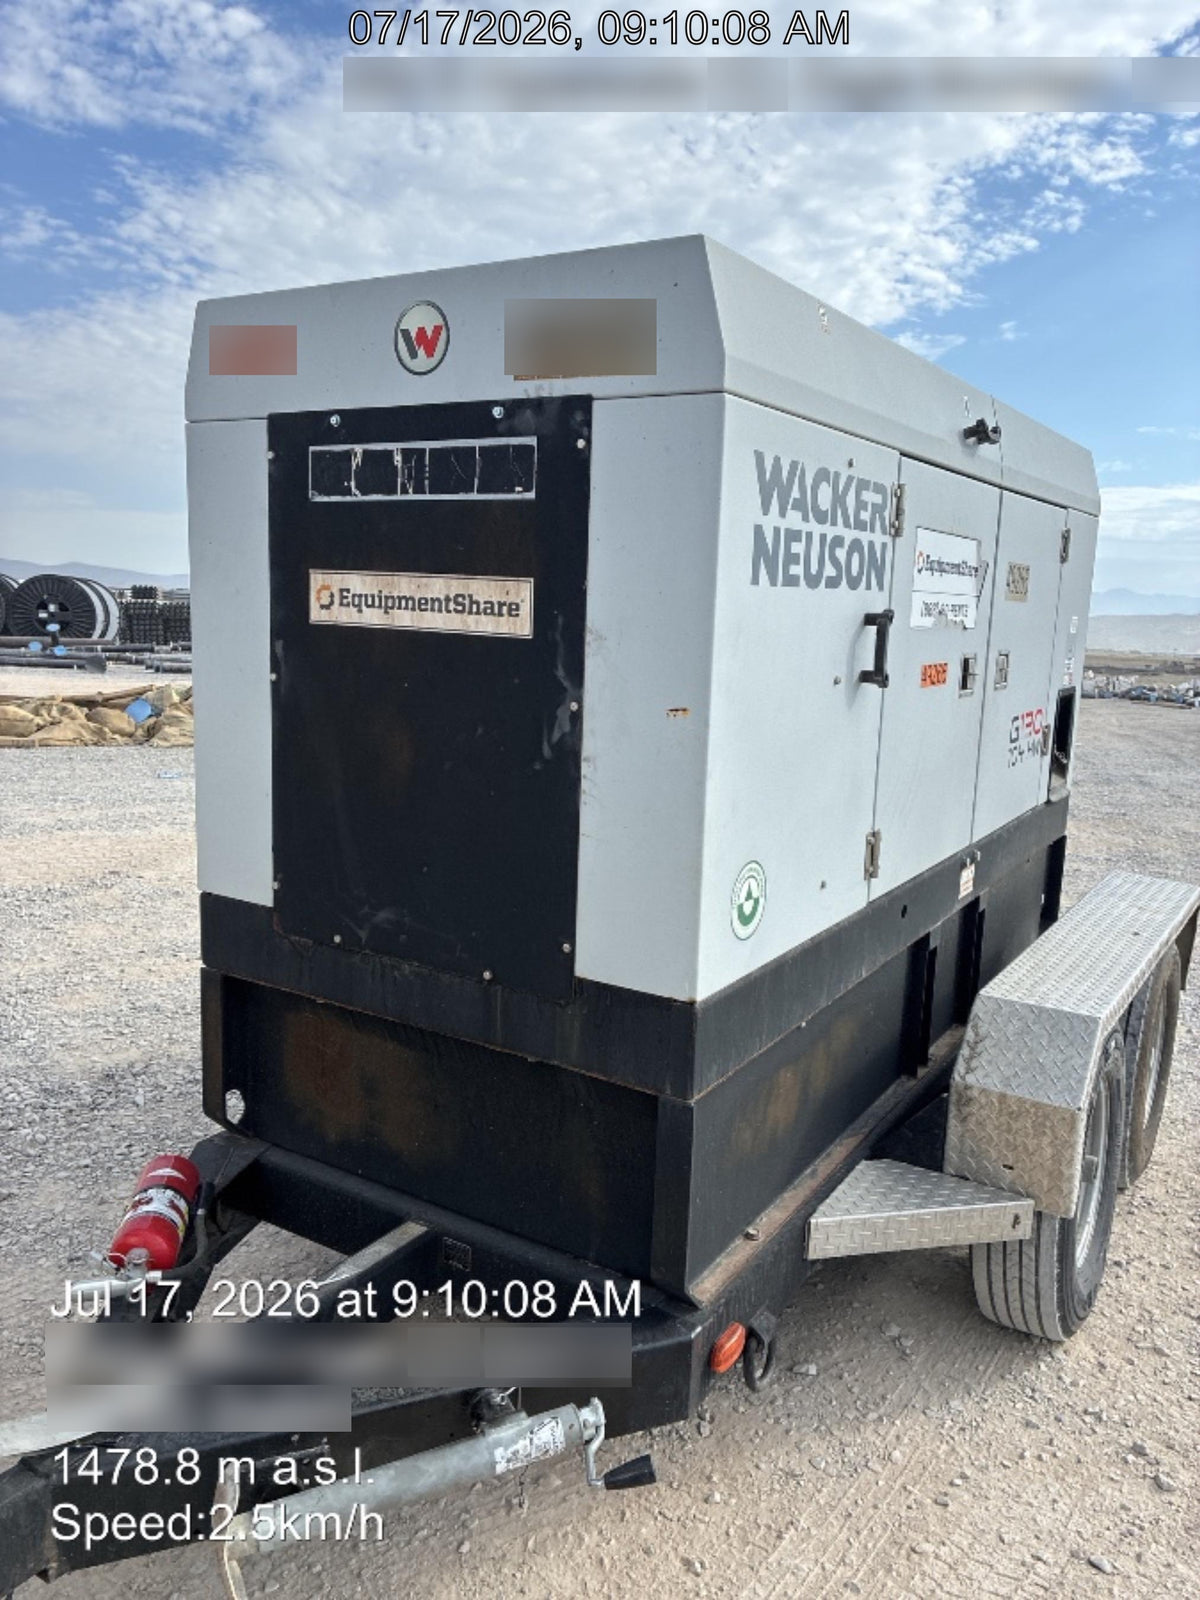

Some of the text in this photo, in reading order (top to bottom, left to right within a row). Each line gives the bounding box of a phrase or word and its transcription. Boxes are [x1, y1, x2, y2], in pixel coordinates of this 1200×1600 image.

[754, 449, 888, 536] WACKER
[750, 524, 888, 592] NEUSON
[338, 588, 522, 618] EquipmentShare
